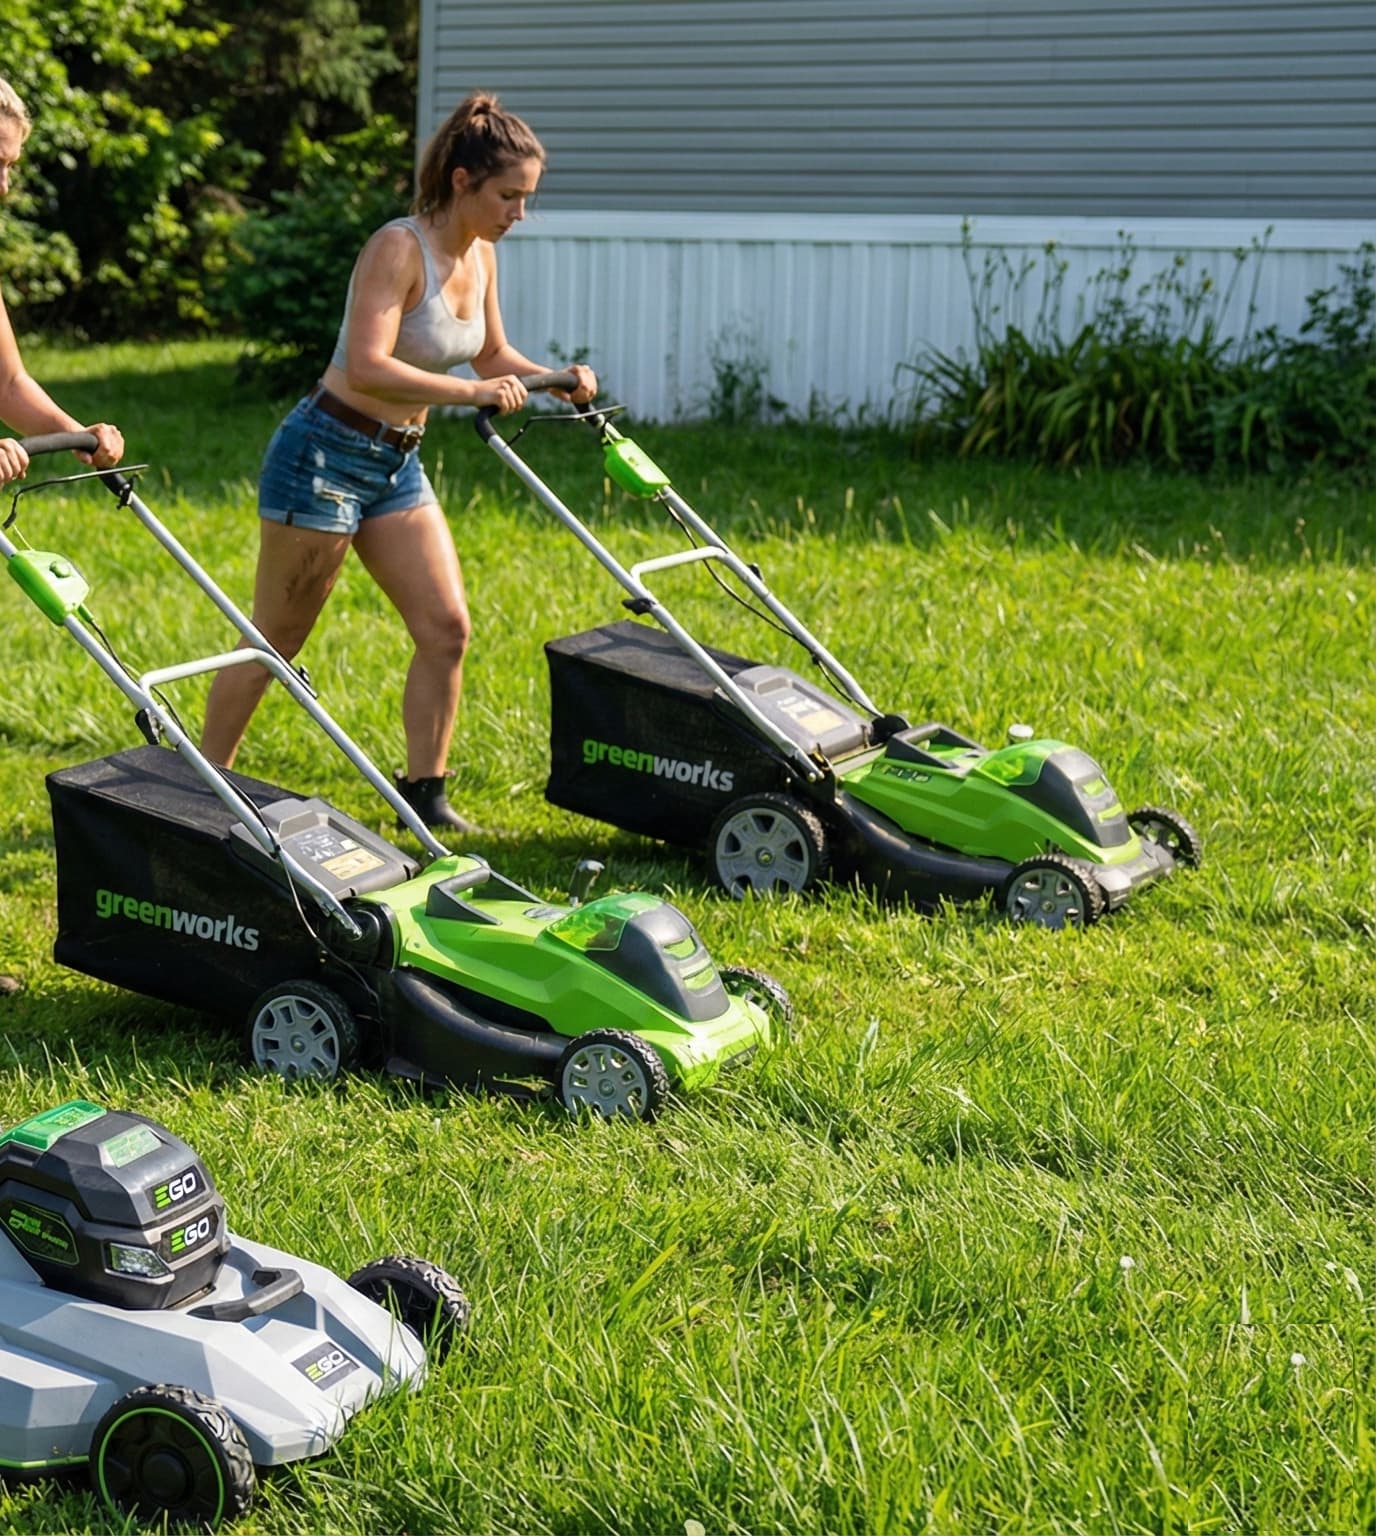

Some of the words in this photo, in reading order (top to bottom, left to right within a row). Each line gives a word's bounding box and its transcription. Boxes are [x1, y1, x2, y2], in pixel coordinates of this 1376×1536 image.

[582, 738, 734, 792] greenworks
[95, 888, 260, 951] greenworks
[154, 1172, 197, 1209] EGO
[170, 1216, 210, 1253] EGO
[305, 1350, 345, 1380] EGO
